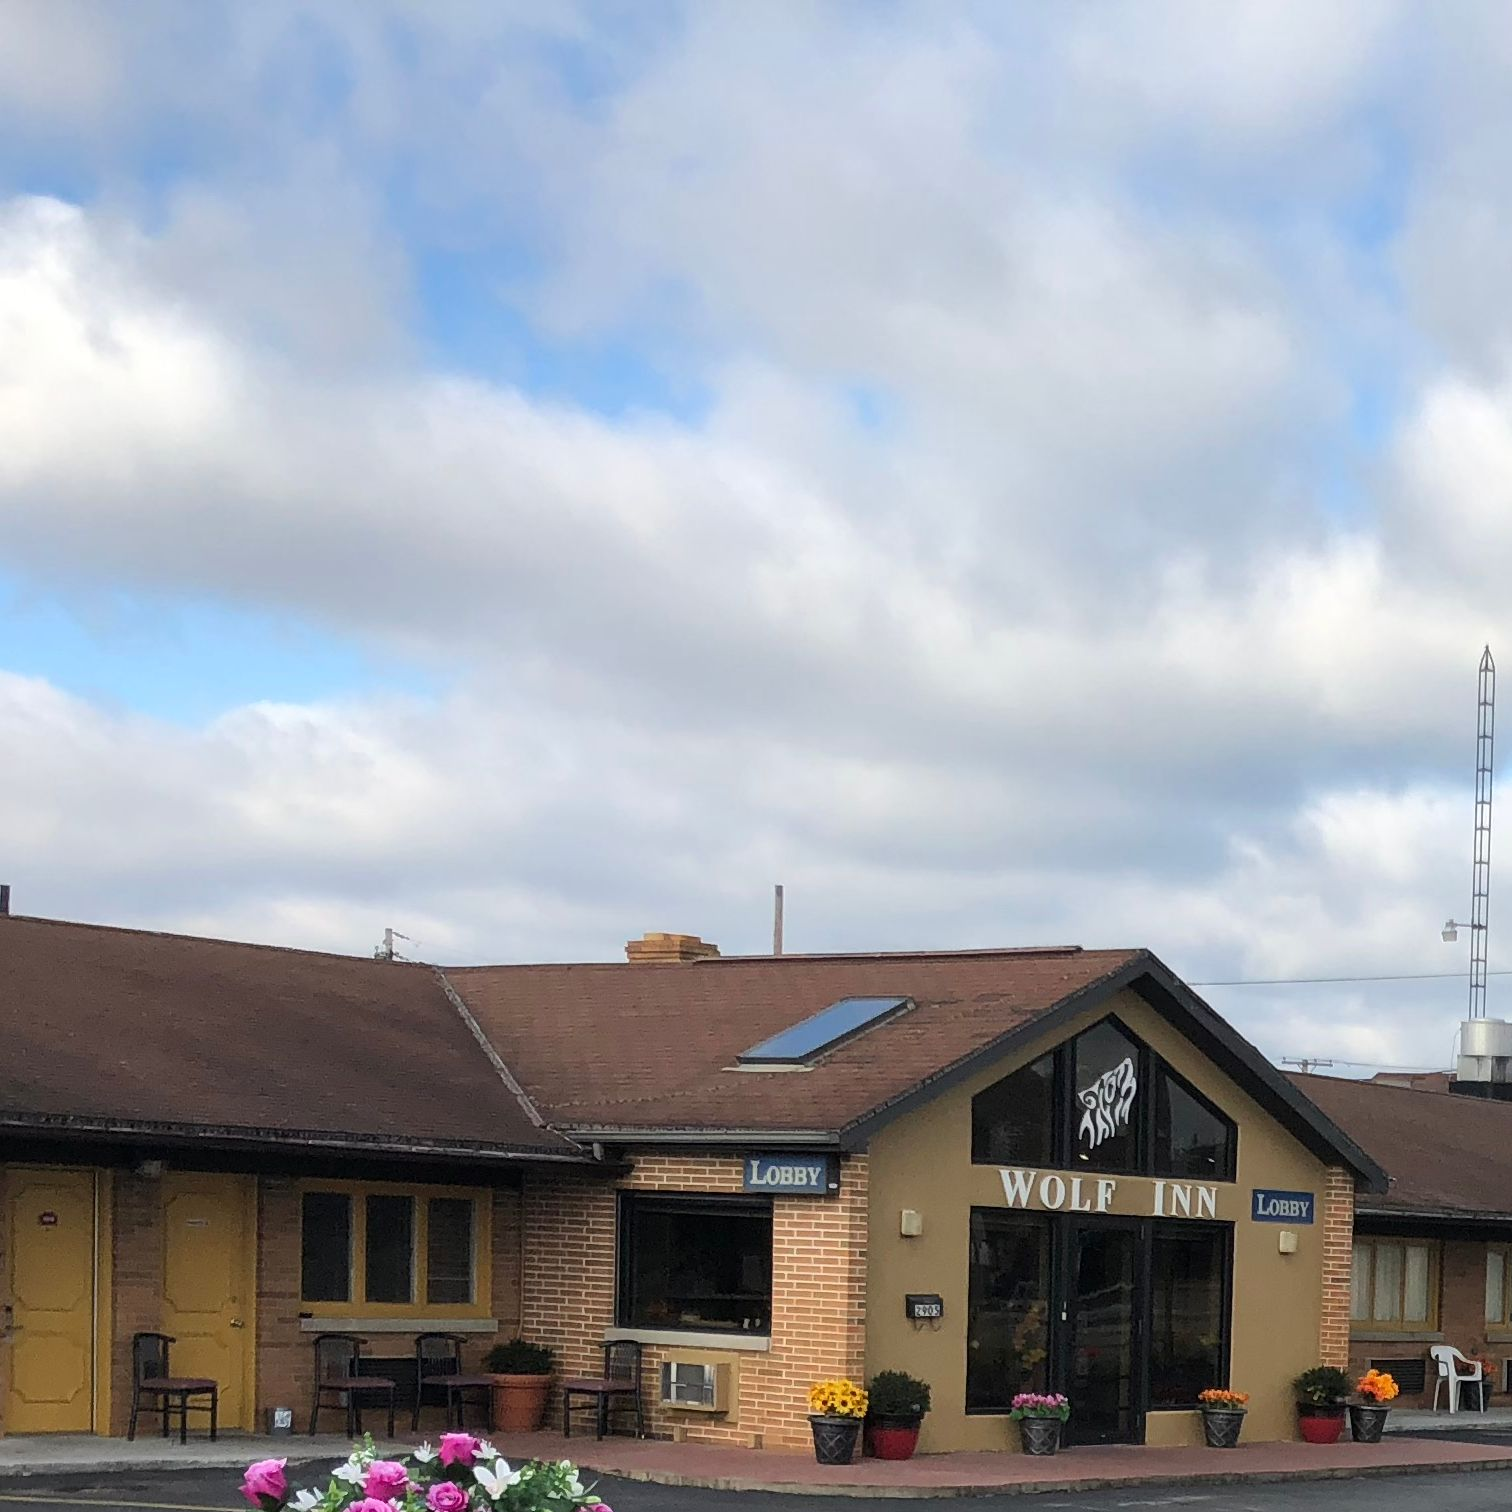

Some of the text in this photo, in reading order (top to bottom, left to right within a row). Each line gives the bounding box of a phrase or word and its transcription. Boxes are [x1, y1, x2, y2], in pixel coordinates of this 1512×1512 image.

[749, 1159, 822, 1186] LOBBY
[998, 1168, 1219, 1220] WOLF INN
[1256, 1194, 1310, 1218] LOBBY
